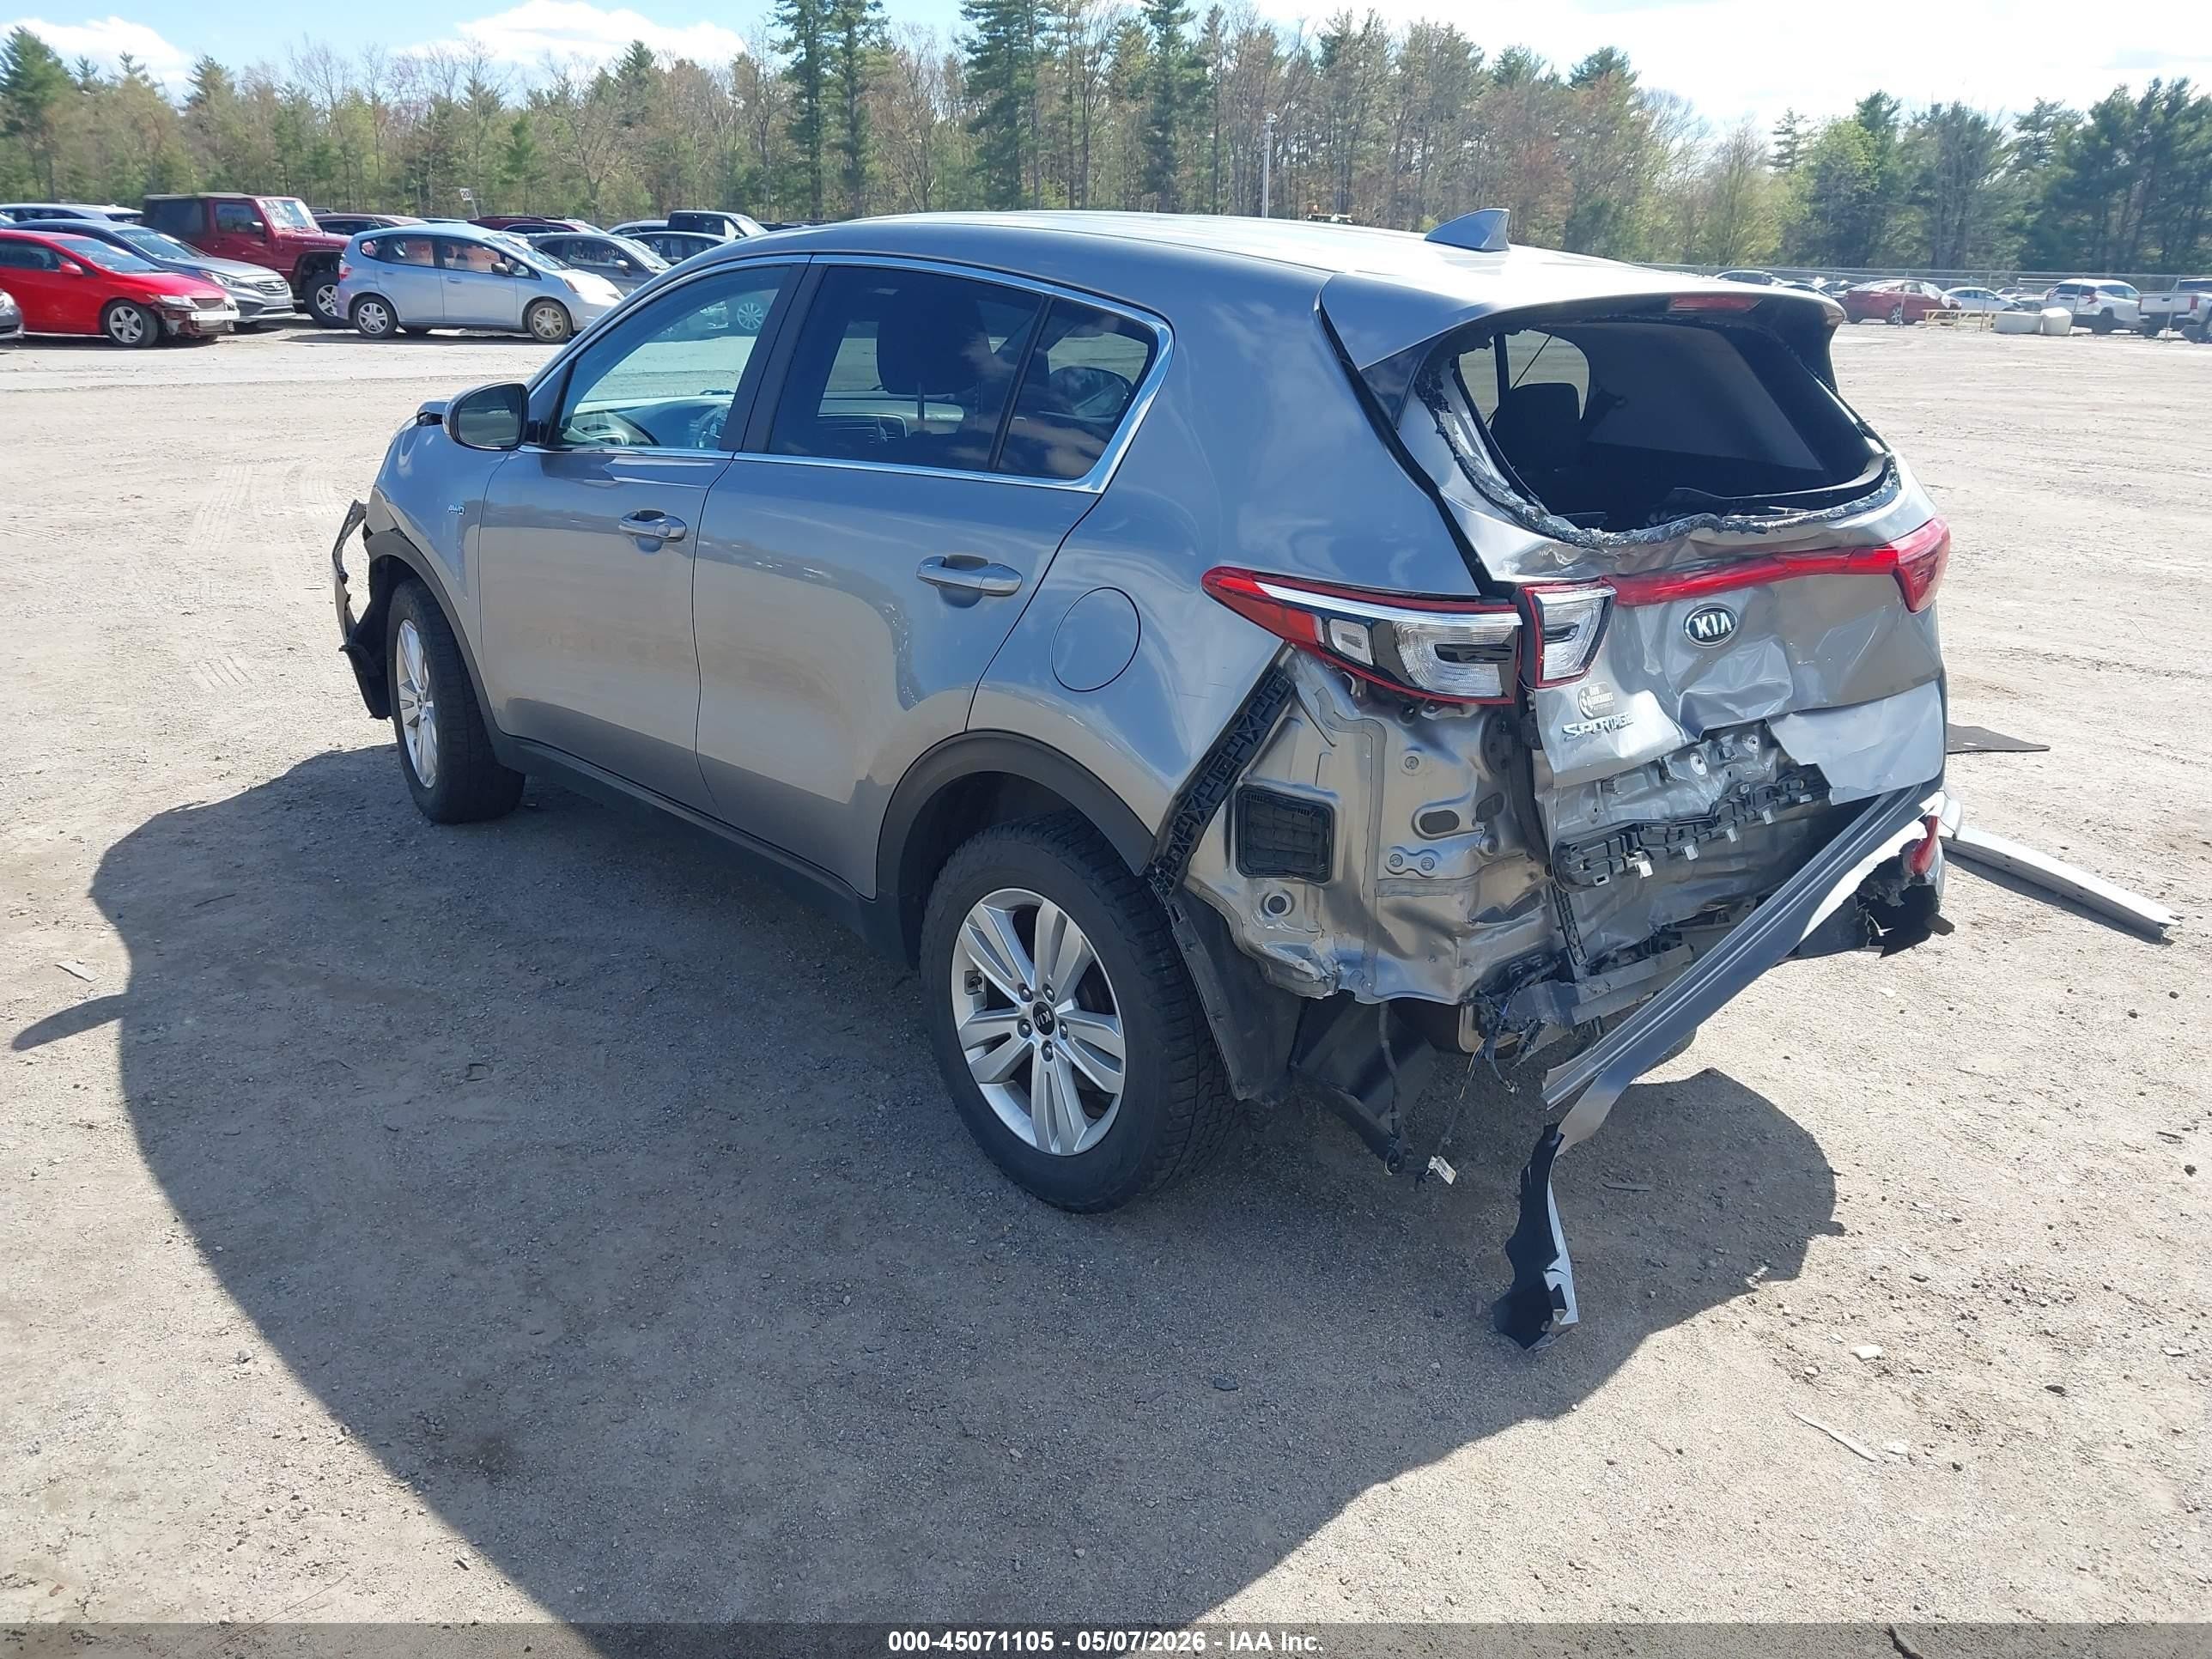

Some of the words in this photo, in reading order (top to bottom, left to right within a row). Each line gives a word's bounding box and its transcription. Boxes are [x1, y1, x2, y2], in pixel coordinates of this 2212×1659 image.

[1693, 611, 1732, 639] KIA
[1562, 712, 1634, 741] SPORTAGE
[1034, 1010, 1052, 1027] KIA
